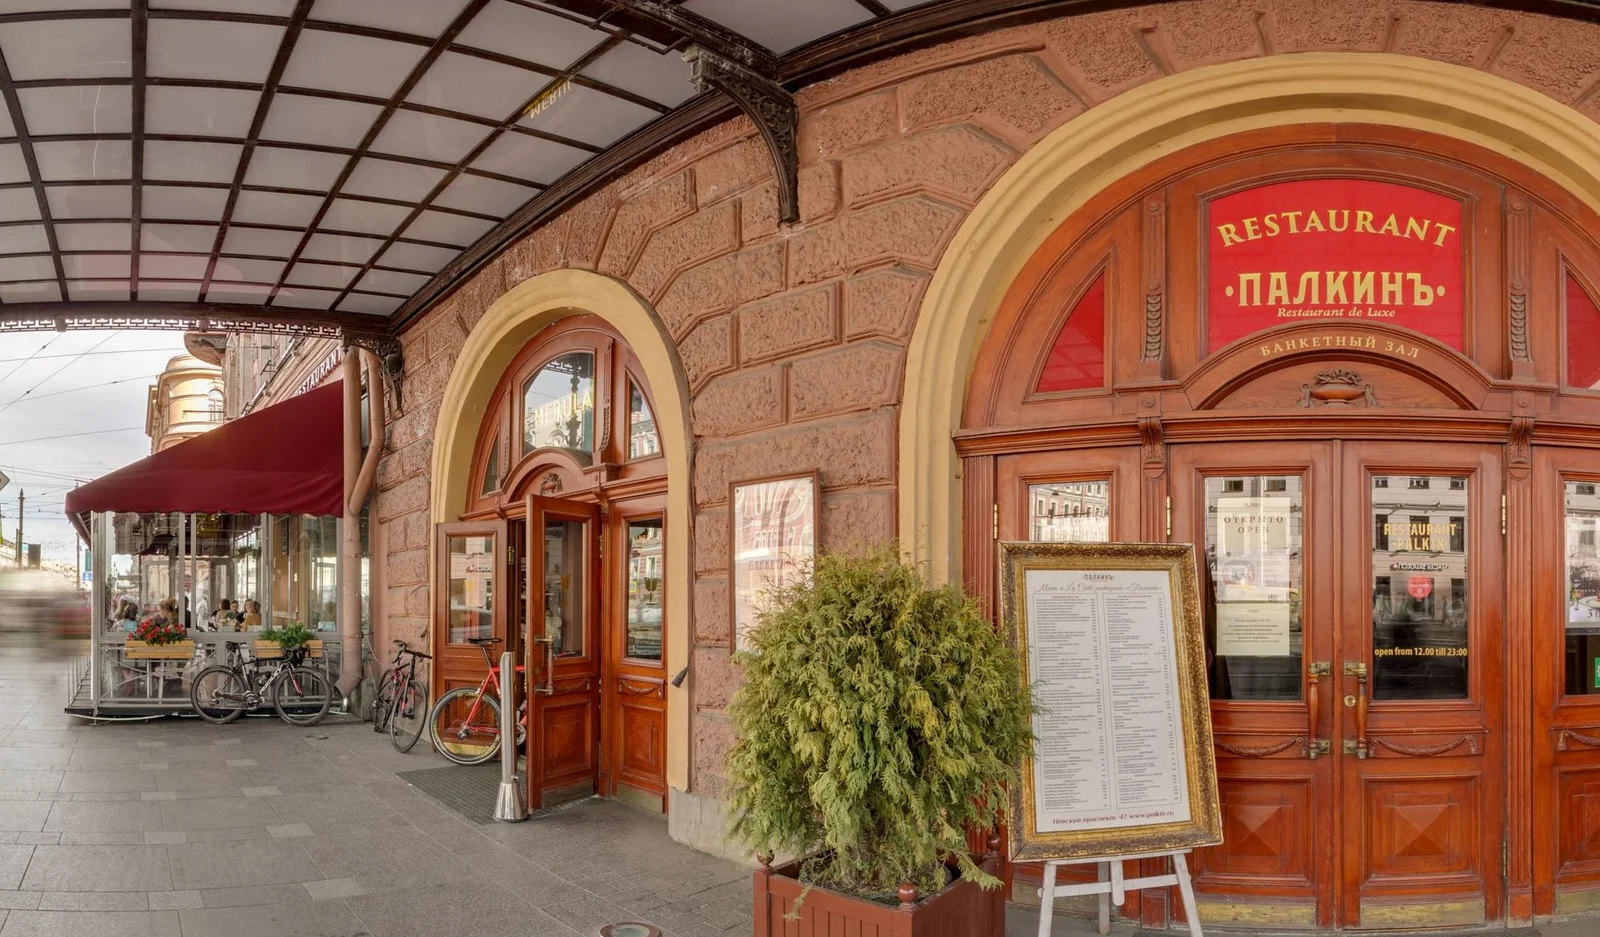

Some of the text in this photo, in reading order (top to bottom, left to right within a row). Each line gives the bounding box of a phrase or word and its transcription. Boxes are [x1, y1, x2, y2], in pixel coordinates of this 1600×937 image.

[1217, 209, 1455, 247] RESTAURANT
[1238, 271, 1434, 306] ПАЛКИНЪ
[1277, 307, 1396, 318] Restaurant de Luxe
[1261, 335, 1420, 359] БАНКЕТНЫЙ ЗАЛ
[1238, 526, 1269, 534] OPEN
[1383, 523, 1457, 536] RESTAURANT
[1374, 647, 1468, 657] open from 12.00 till 23:00
